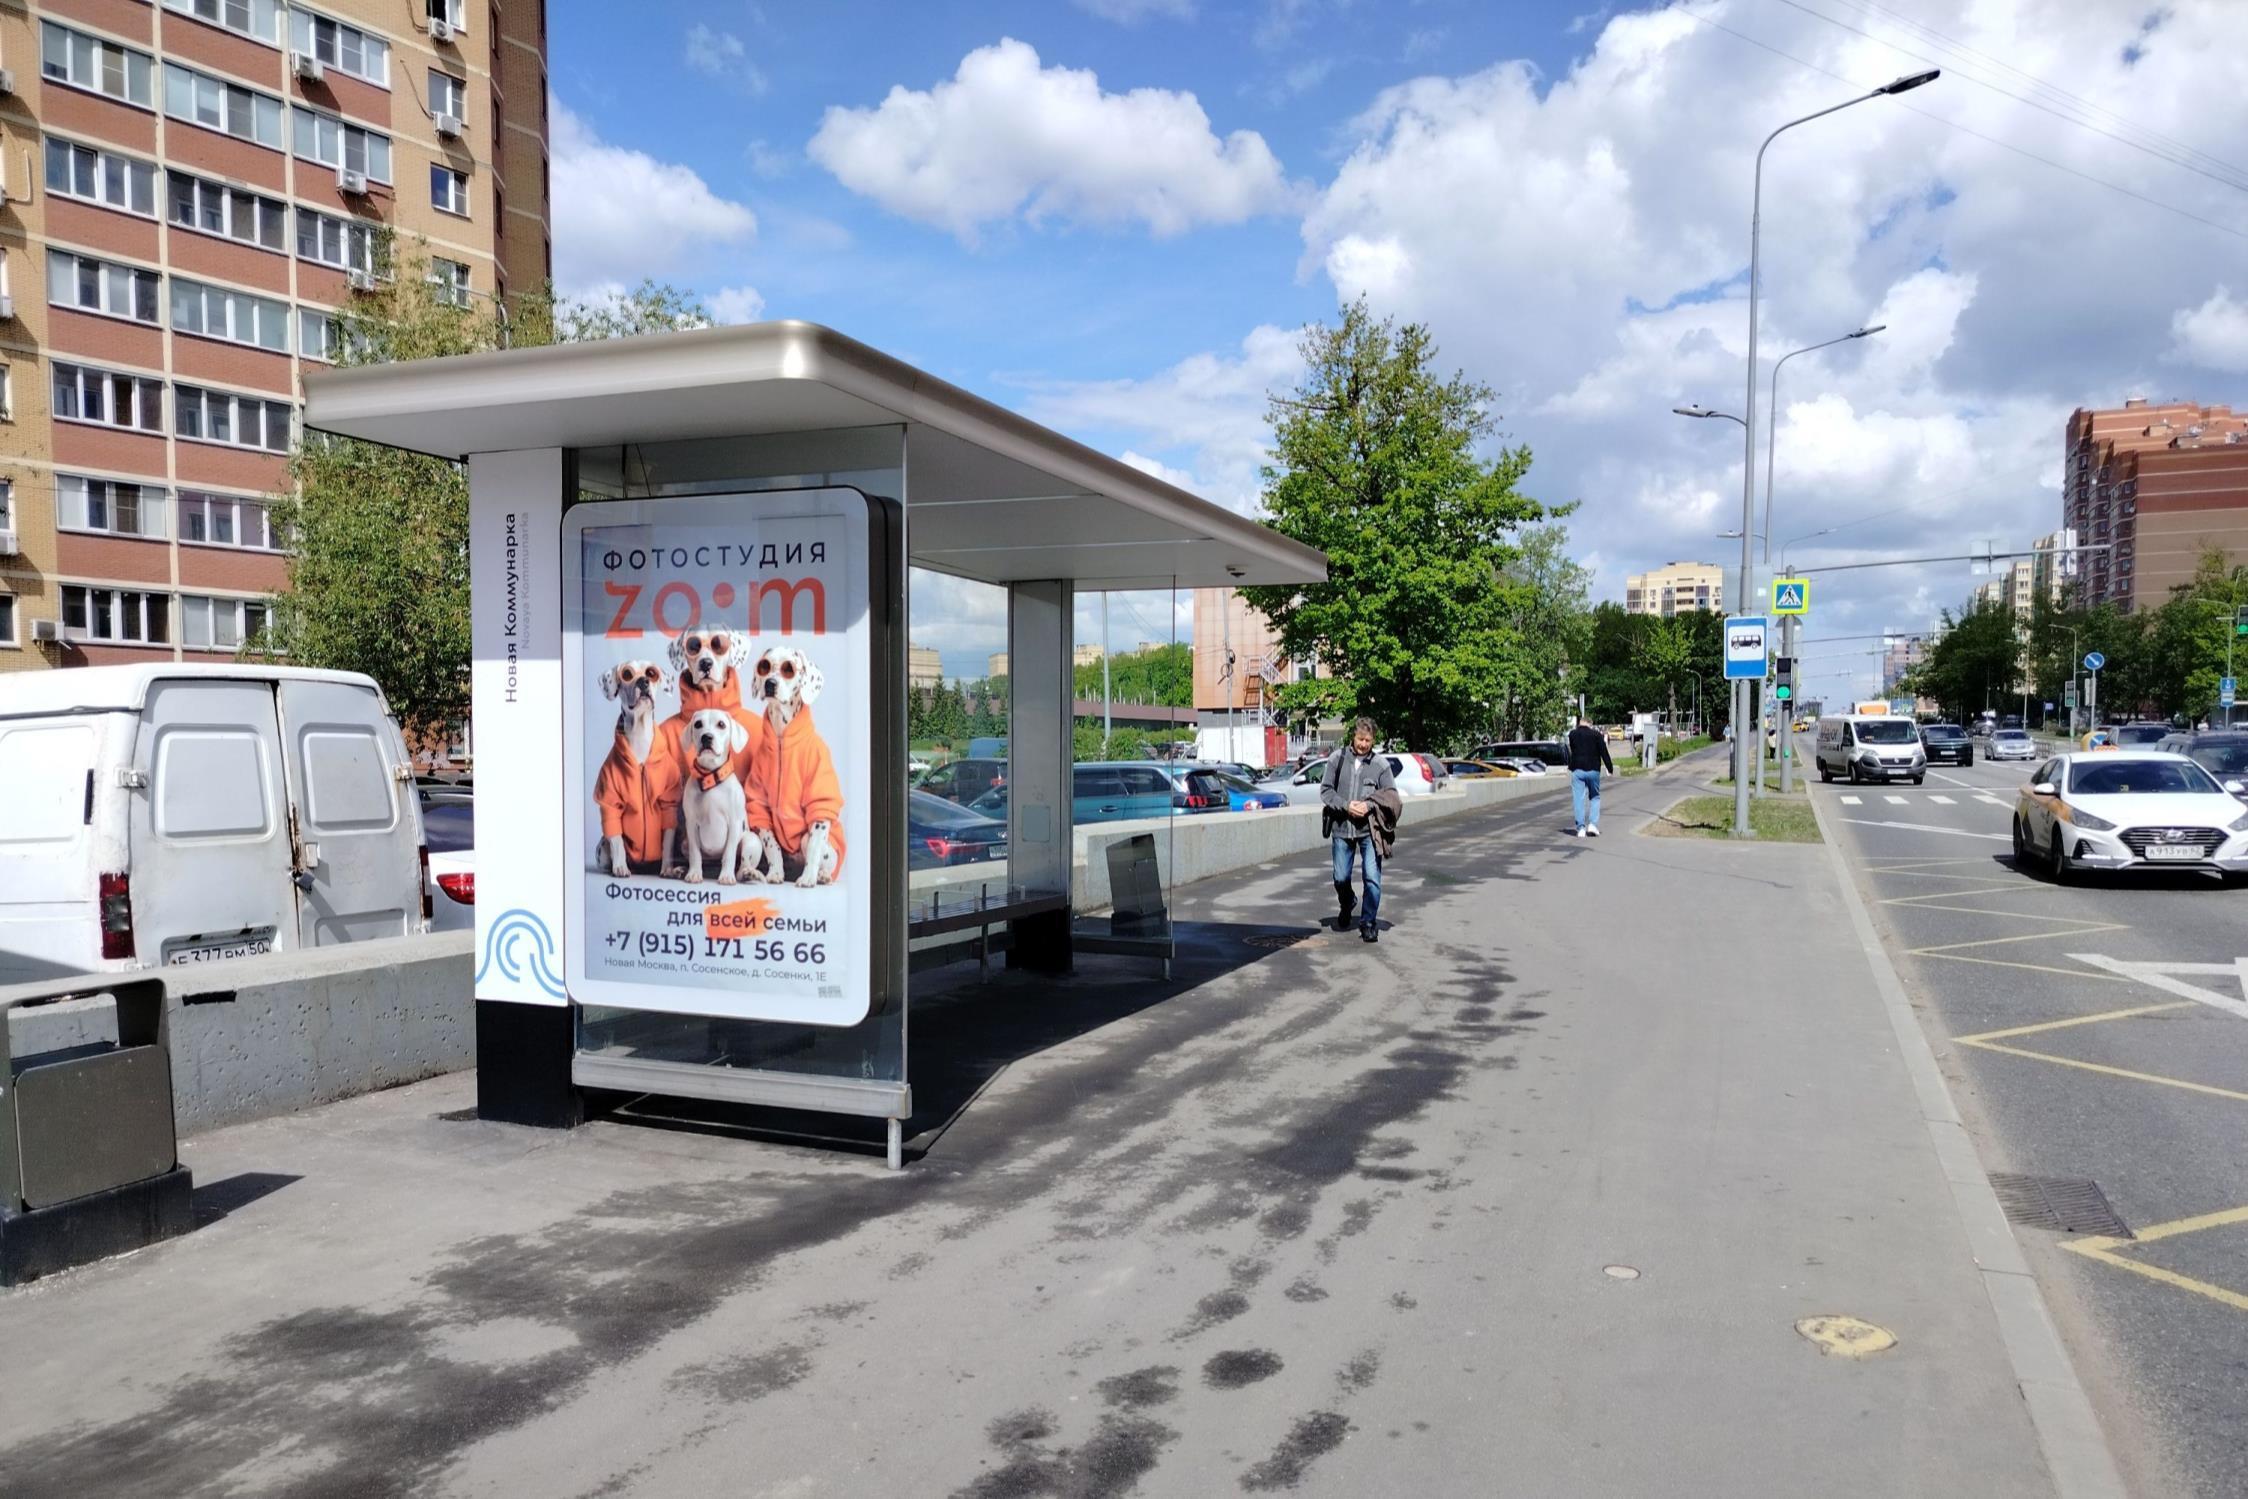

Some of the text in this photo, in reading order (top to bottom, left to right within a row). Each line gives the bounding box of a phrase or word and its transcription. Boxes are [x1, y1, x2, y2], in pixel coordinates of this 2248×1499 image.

[603, 542, 826, 571] ФОТОСТУДИЯ
[521, 511, 530, 649] Novaya Kommunarka
[505, 513, 519, 703] Новая Коммунарка
[605, 883, 721, 904] Фотосессия
[667, 911, 827, 933] для всей семьи
[605, 931, 826, 965] +7 (915) 171 56 66
[605, 957, 635, 968] Новая
[638, 960, 678, 973] Москва,
[691, 963, 749, 977] Сосенское,
[764, 968, 813, 983] Сосенки,
